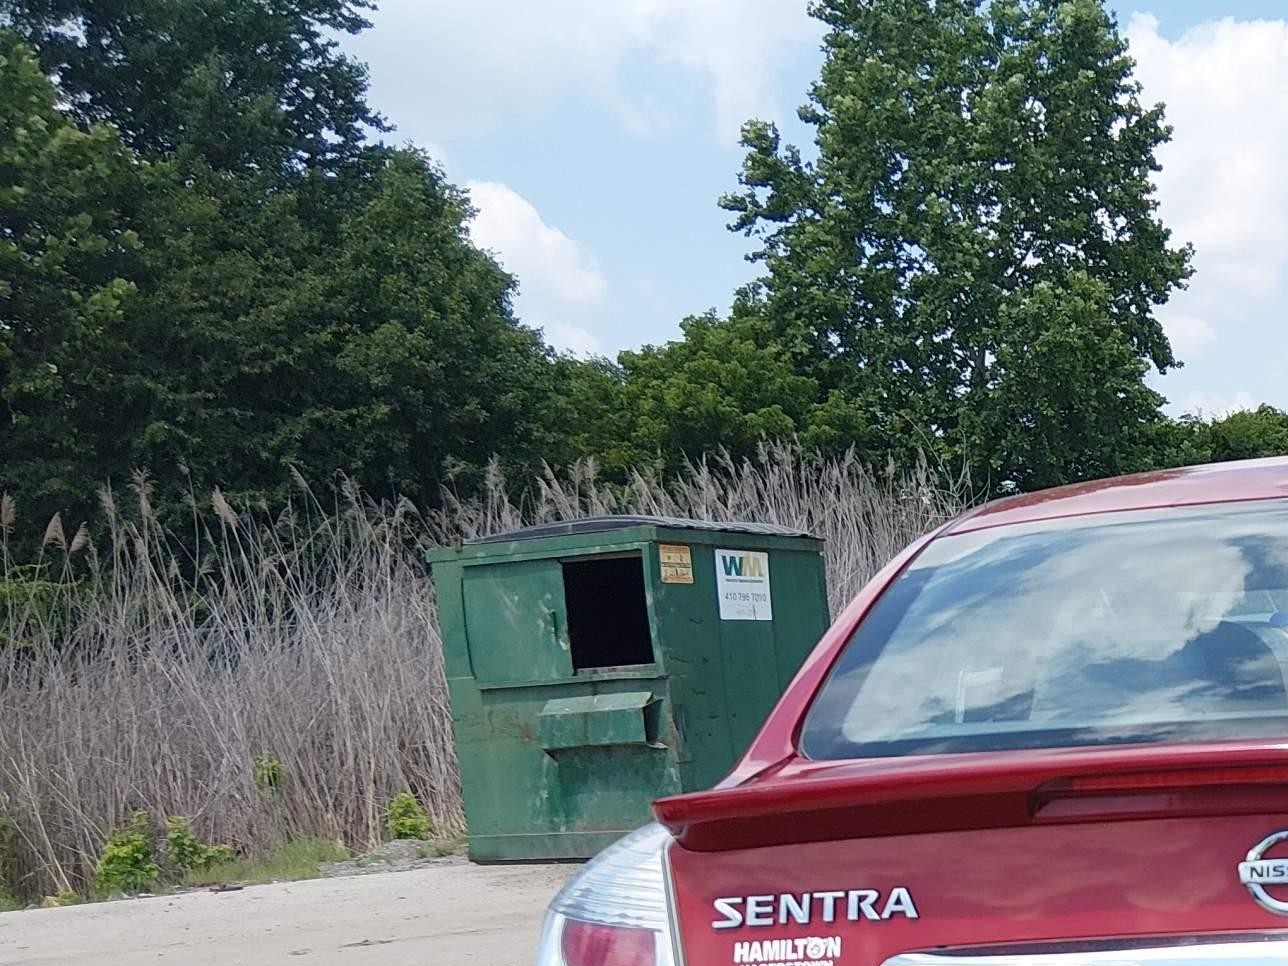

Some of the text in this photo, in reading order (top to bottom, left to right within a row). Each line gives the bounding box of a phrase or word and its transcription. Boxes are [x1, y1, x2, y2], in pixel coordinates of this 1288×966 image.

[721, 555, 763, 577] WM
[725, 592, 738, 601] 410
[712, 887, 919, 928] SENTRA
[733, 936, 841, 963] HAMILTON
